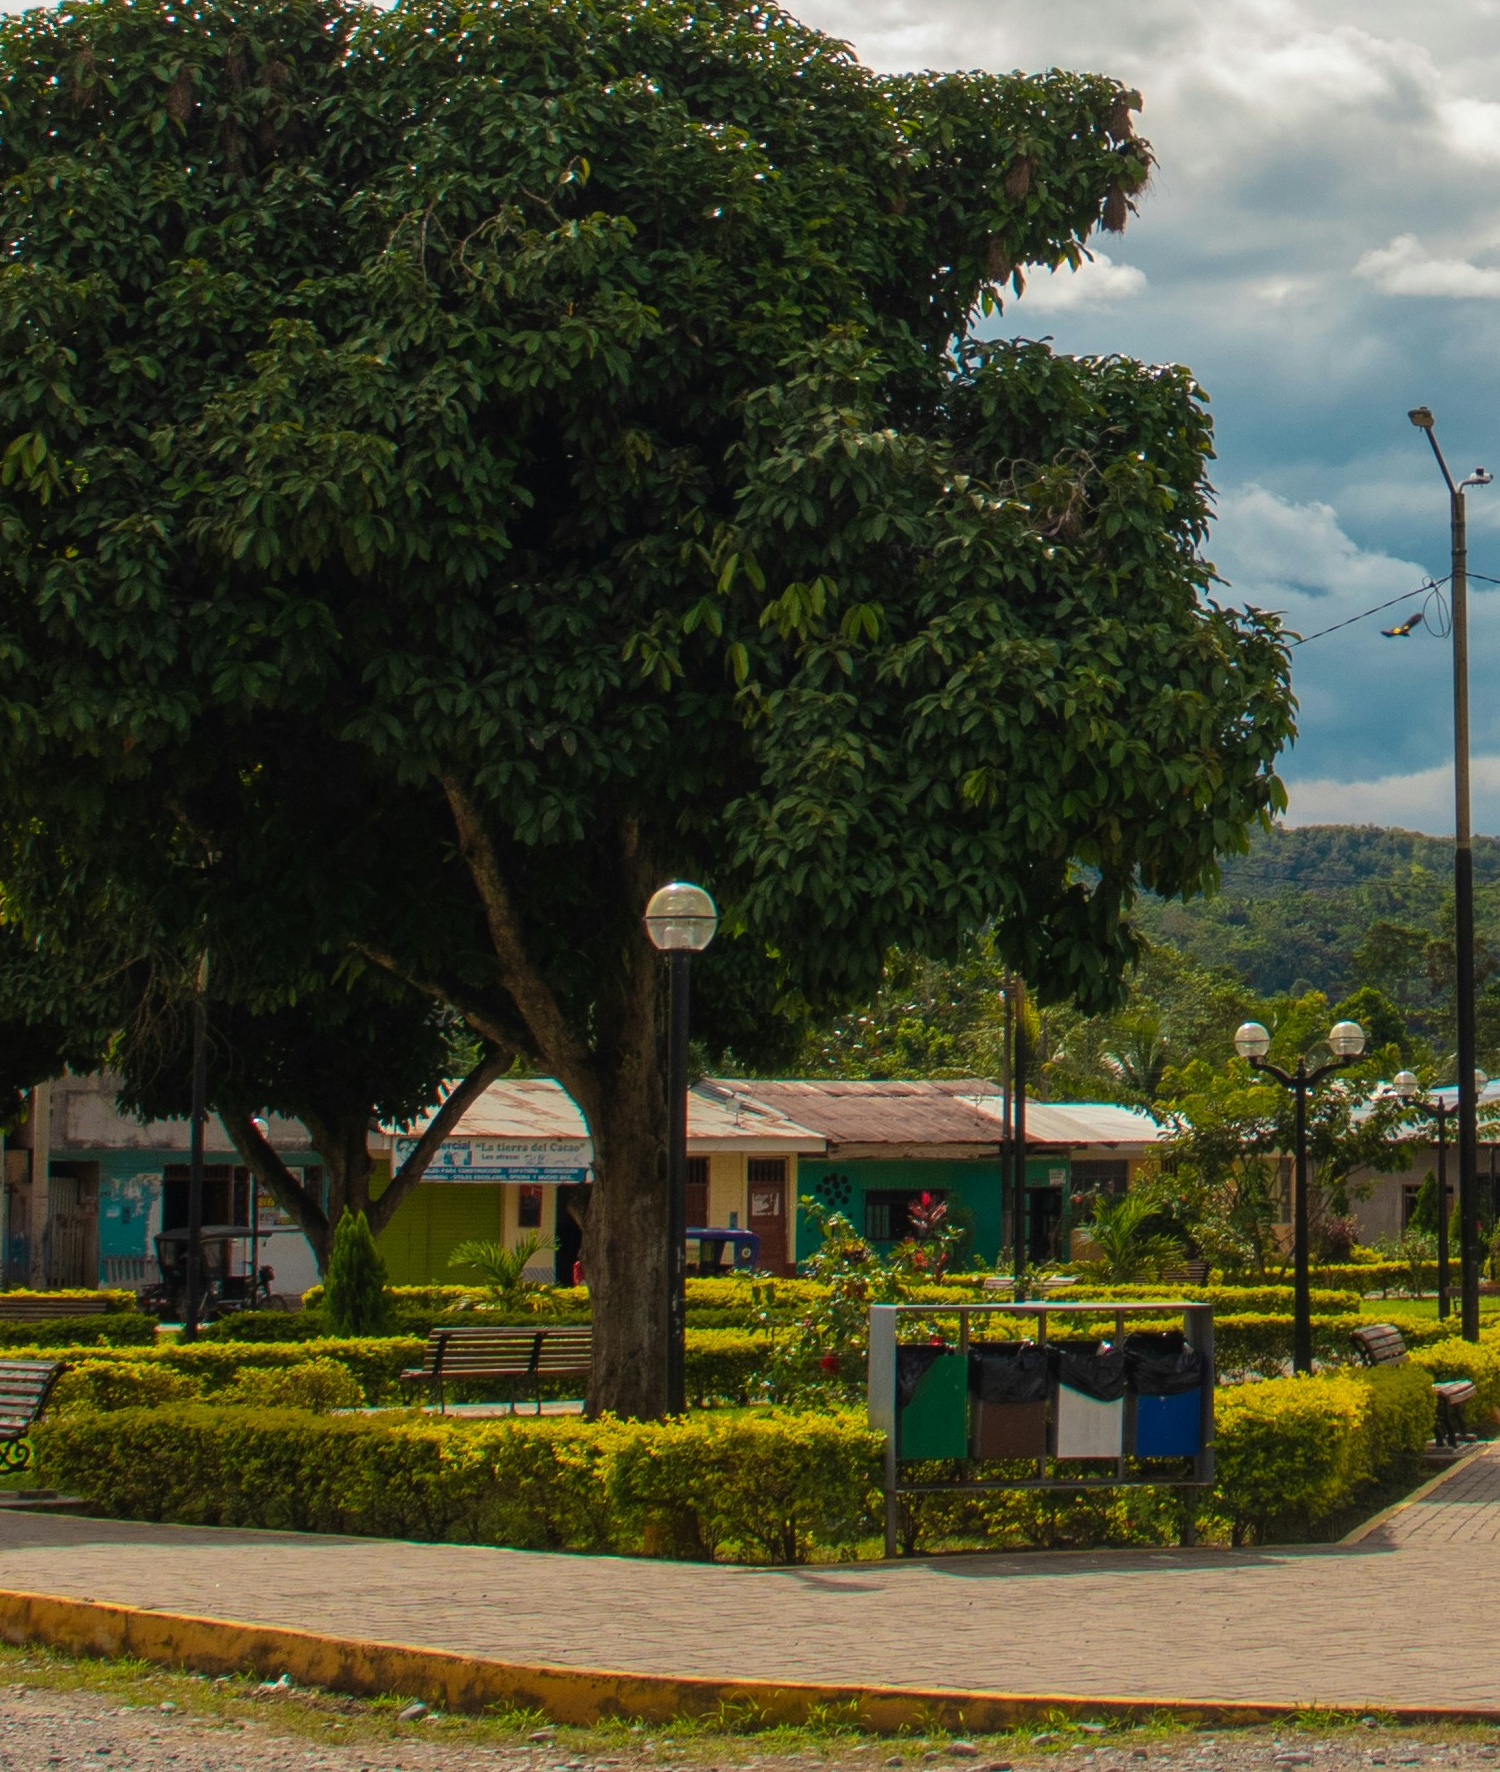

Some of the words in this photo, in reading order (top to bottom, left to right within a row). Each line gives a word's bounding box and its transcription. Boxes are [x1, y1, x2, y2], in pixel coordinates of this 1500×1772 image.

[438, 1140, 471, 1150] ercial
[497, 1142, 528, 1152] tierra
[531, 1142, 547, 1152] del
